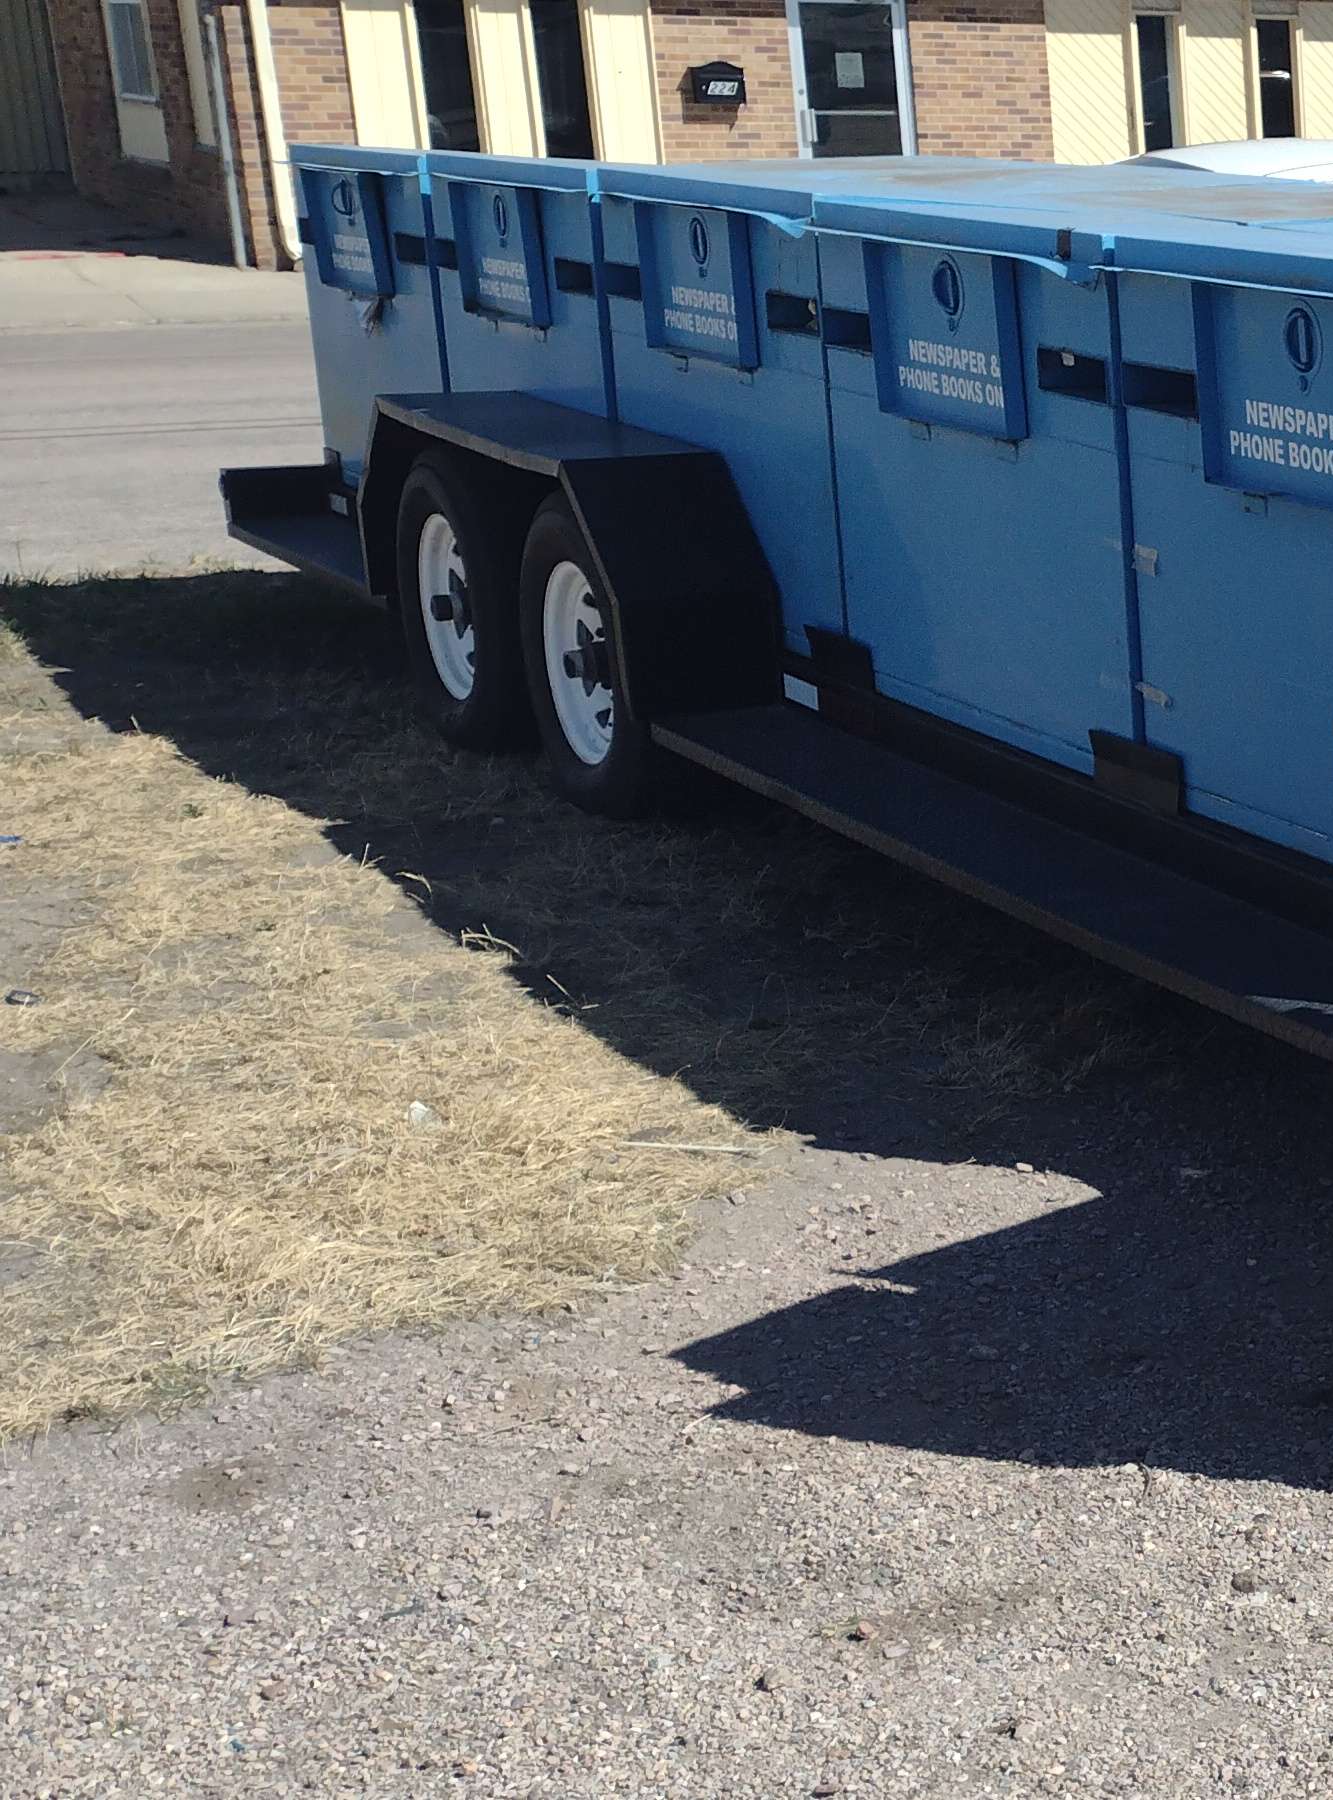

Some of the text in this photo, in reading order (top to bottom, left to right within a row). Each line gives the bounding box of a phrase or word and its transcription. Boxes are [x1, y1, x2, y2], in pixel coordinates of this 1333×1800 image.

[709, 82, 737, 95] 224
[671, 286, 729, 315] NEWSPAPER
[664, 308, 694, 333] PHONE
[694, 313, 727, 340] BOOKS
[907, 338, 988, 376] NEWSPAPER
[898, 365, 941, 396] PHONE
[940, 374, 984, 405] BOOKS
[1229, 429, 1286, 466] PHONE
